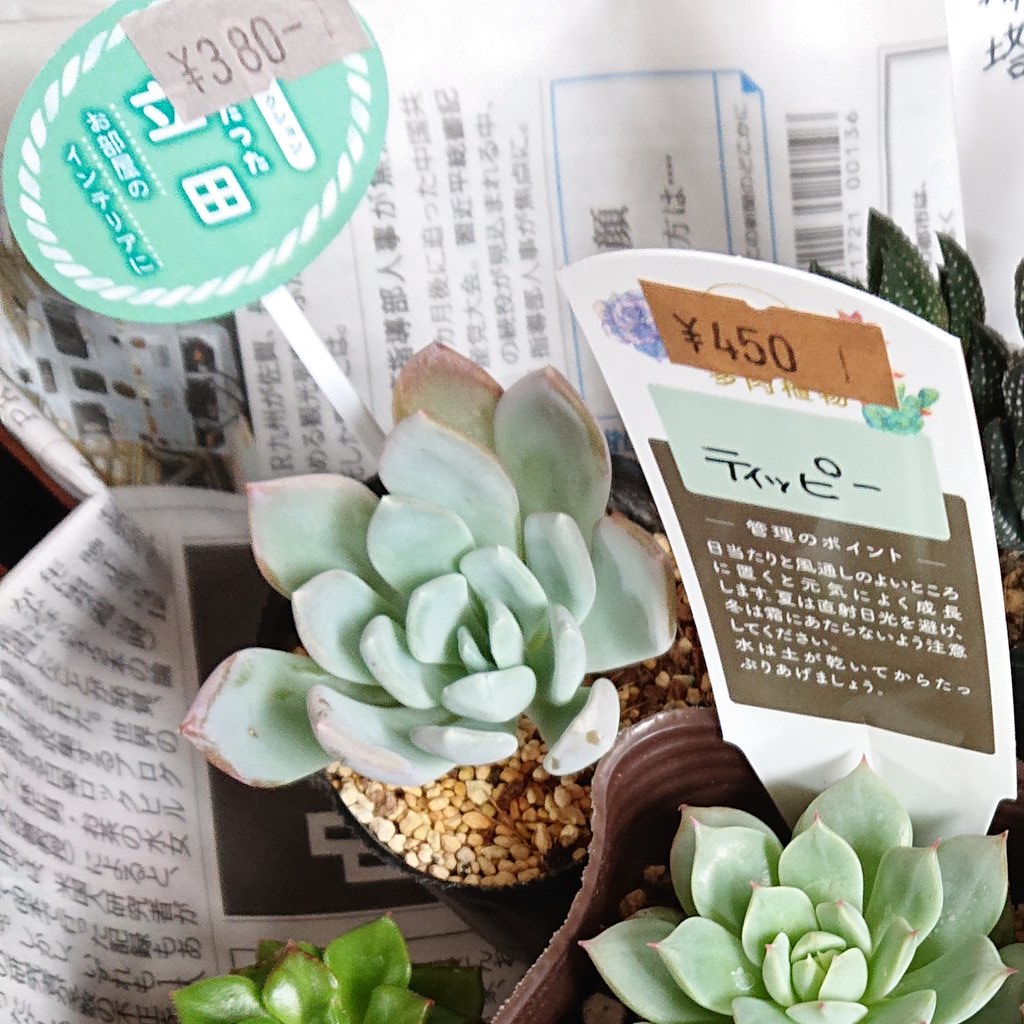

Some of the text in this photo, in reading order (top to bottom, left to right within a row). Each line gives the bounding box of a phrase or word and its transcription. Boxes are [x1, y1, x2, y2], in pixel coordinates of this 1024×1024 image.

[746, 519, 902, 563] 管理のポイント
[707, 540, 959, 601] 日当たりと風通しのよいところ
